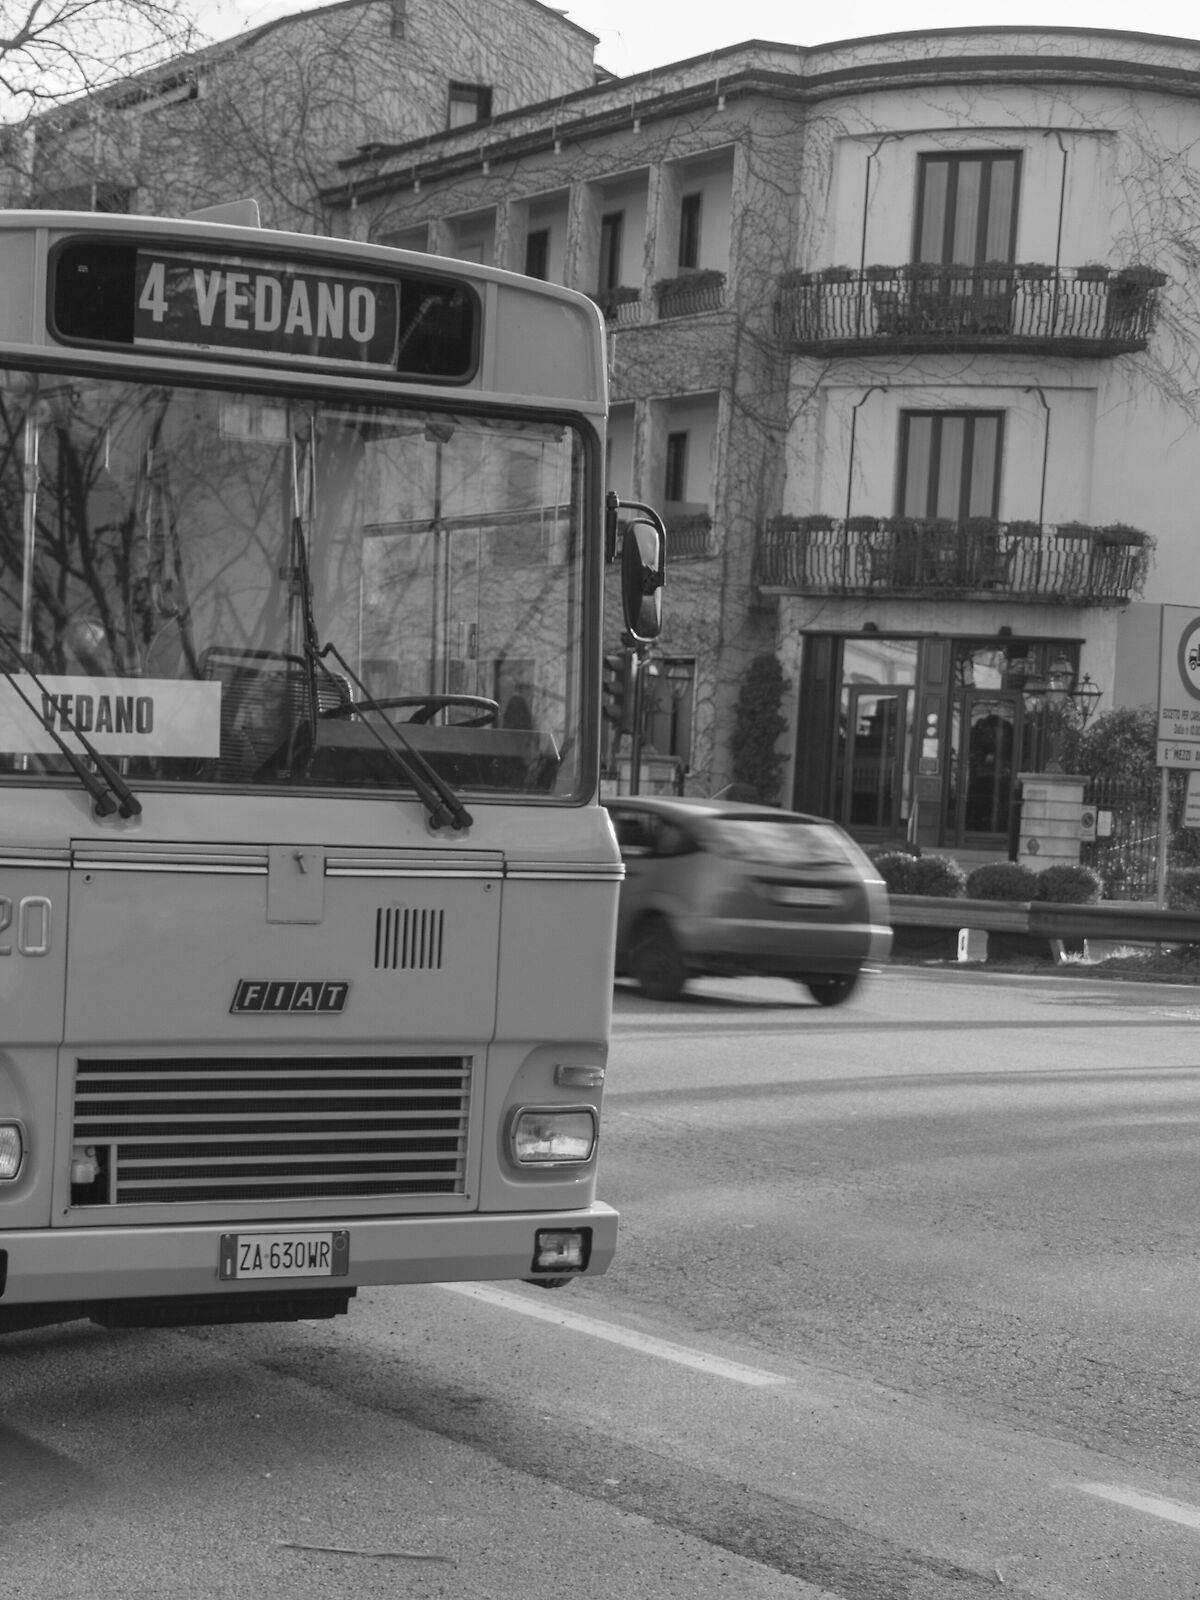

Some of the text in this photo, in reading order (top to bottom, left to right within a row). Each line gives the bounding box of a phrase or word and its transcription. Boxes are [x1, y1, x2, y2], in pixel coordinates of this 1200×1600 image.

[138, 262, 376, 343] 4 VEDANO
[41, 693, 154, 734] VEDANO
[1165, 748, 1169, 760] E
[243, 985, 343, 1007] FIAT
